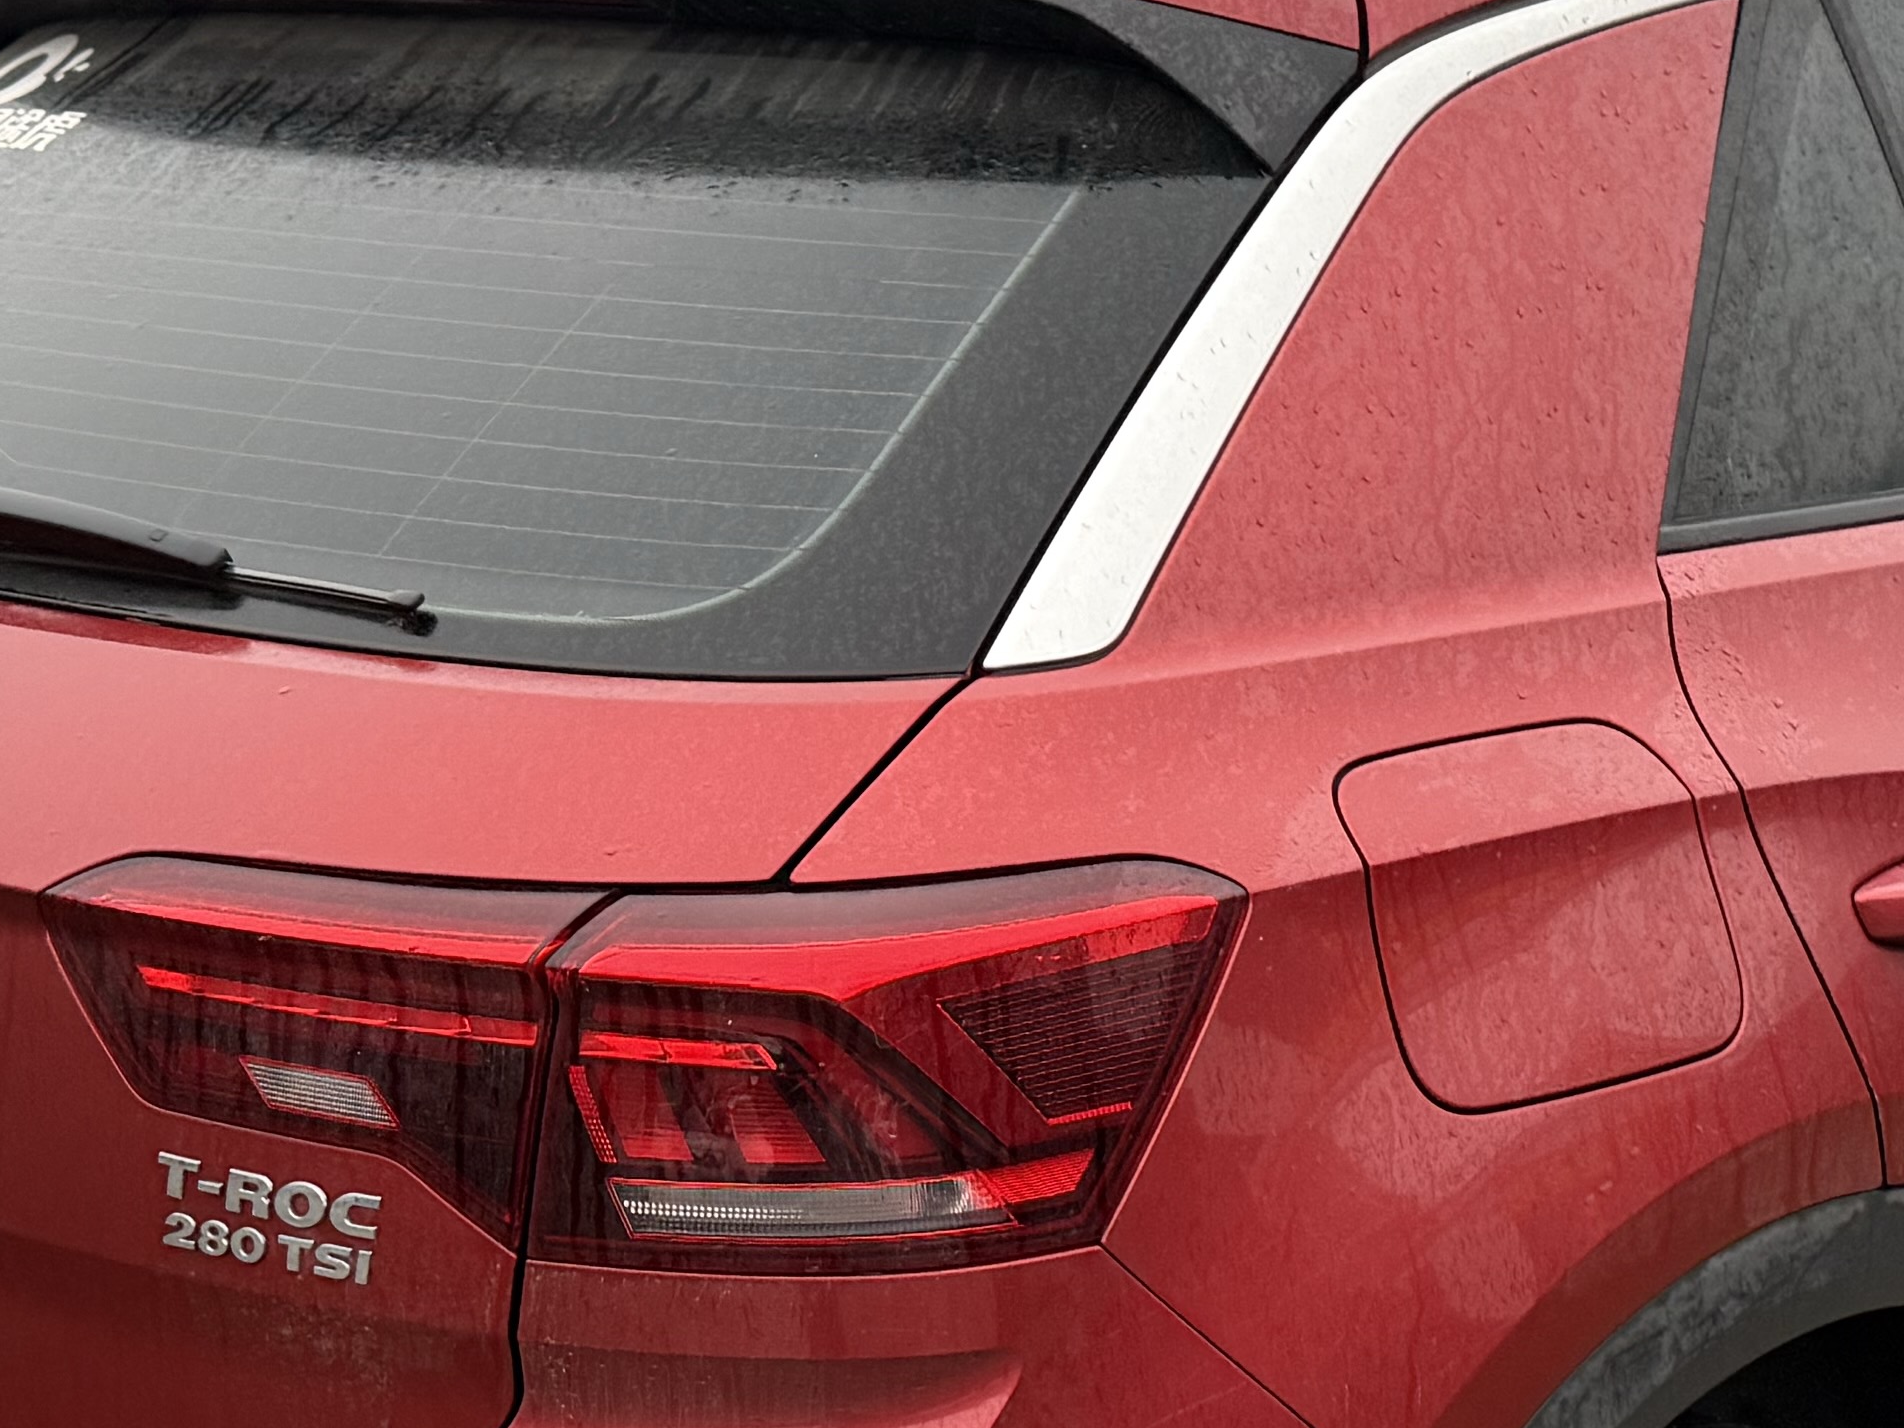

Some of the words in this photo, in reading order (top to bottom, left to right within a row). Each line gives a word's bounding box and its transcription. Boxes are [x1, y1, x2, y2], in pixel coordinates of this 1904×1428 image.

[157, 1150, 383, 1240] T-ROC
[162, 1211, 267, 1264] 280
[277, 1233, 373, 1285] TSI
